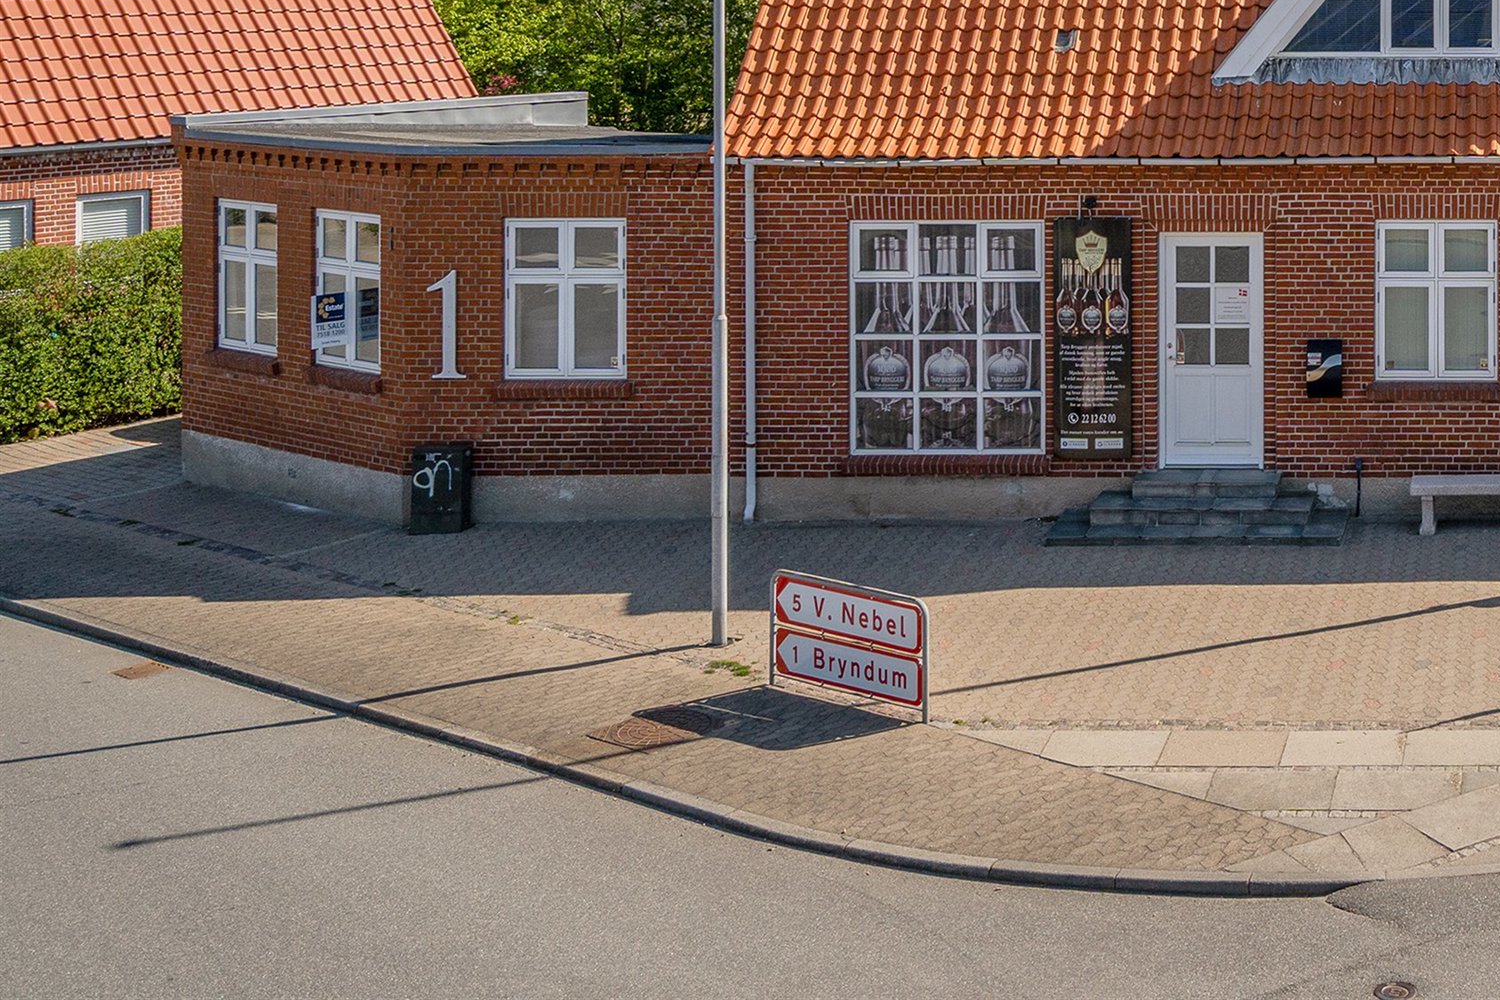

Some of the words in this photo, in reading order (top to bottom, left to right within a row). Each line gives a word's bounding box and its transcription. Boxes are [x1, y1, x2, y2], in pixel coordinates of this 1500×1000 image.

[316, 324, 326, 332] TIL
[328, 321, 346, 330] SALG
[426, 269, 467, 378] 1
[1081, 413, 1090, 424] 22
[1090, 413, 1098, 424] 12
[1107, 413, 1117, 424] 00
[792, 593, 802, 613] 5
[813, 595, 832, 621] V.
[841, 601, 906, 638] Nebel
[792, 645, 799, 664] 1
[813, 647, 908, 690] Bryndum
